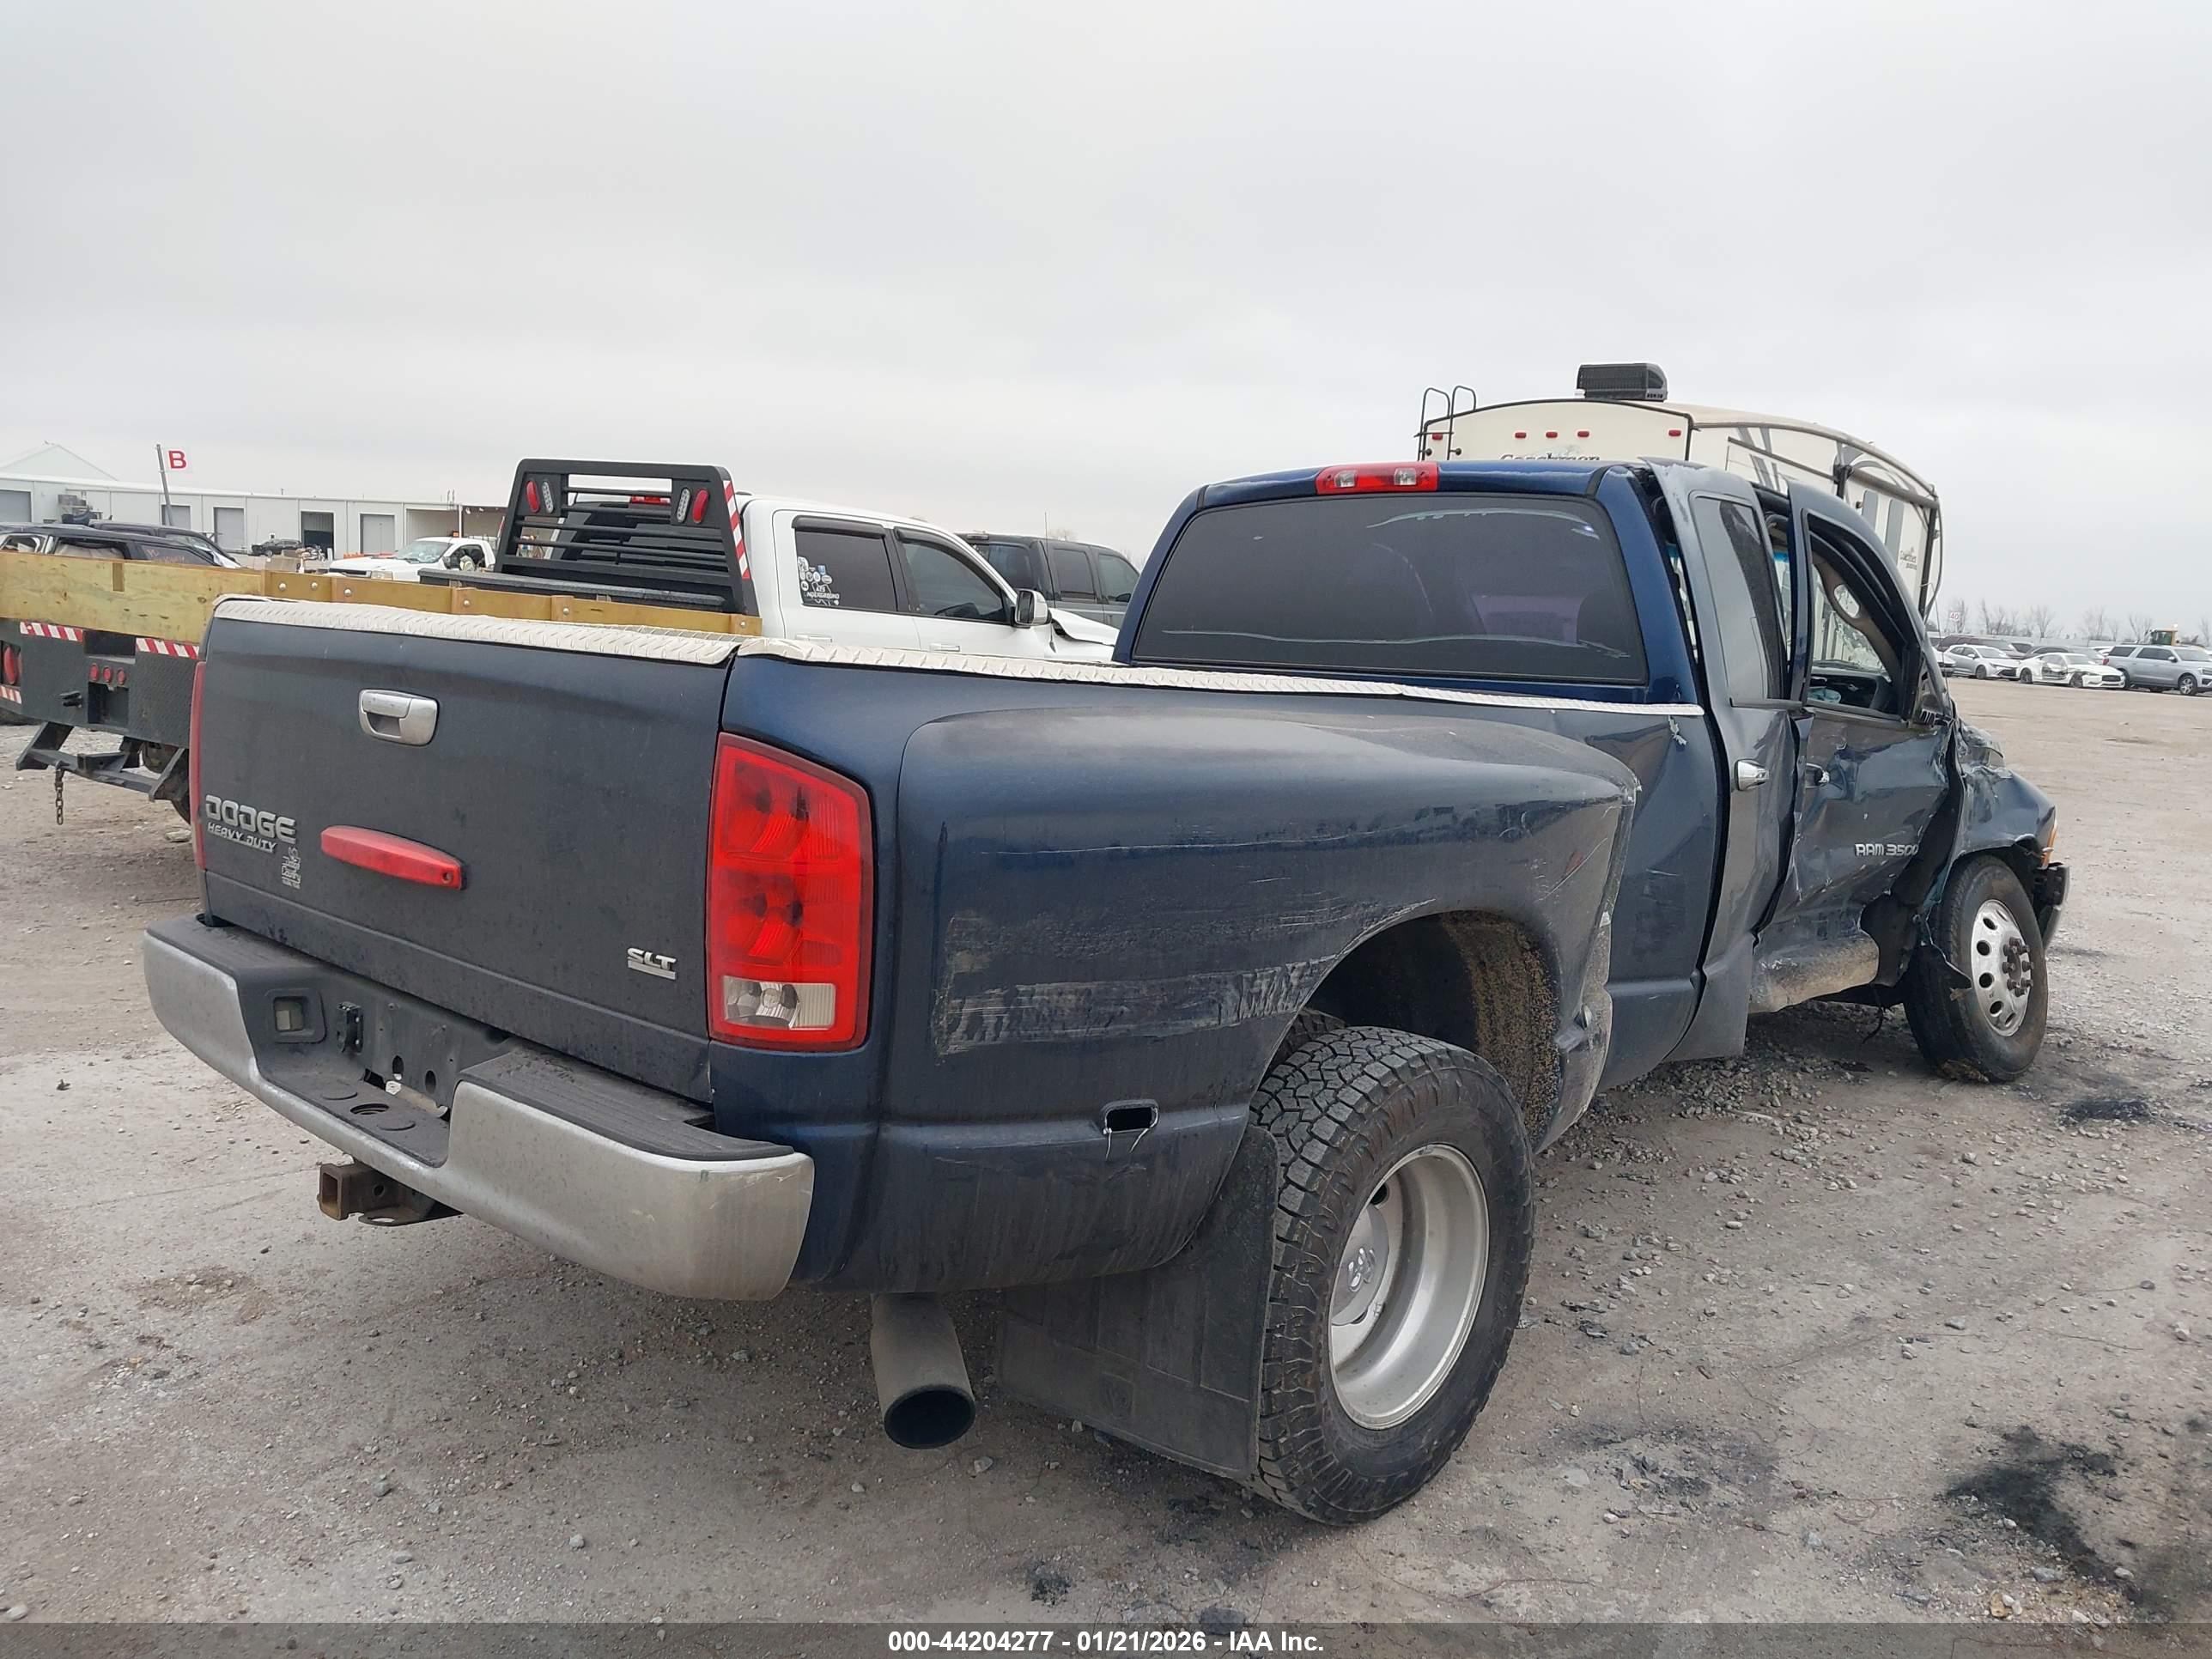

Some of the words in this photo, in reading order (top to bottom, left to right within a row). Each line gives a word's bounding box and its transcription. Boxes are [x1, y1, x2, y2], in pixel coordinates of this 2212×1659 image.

[168, 450, 187, 469] B
[205, 794, 296, 845] DODGE
[207, 822, 243, 842] HEAVY
[246, 836, 277, 853] DUTY
[1855, 843, 1884, 856] RAM
[1885, 843, 1919, 857] 3500
[627, 947, 677, 970] SLT
